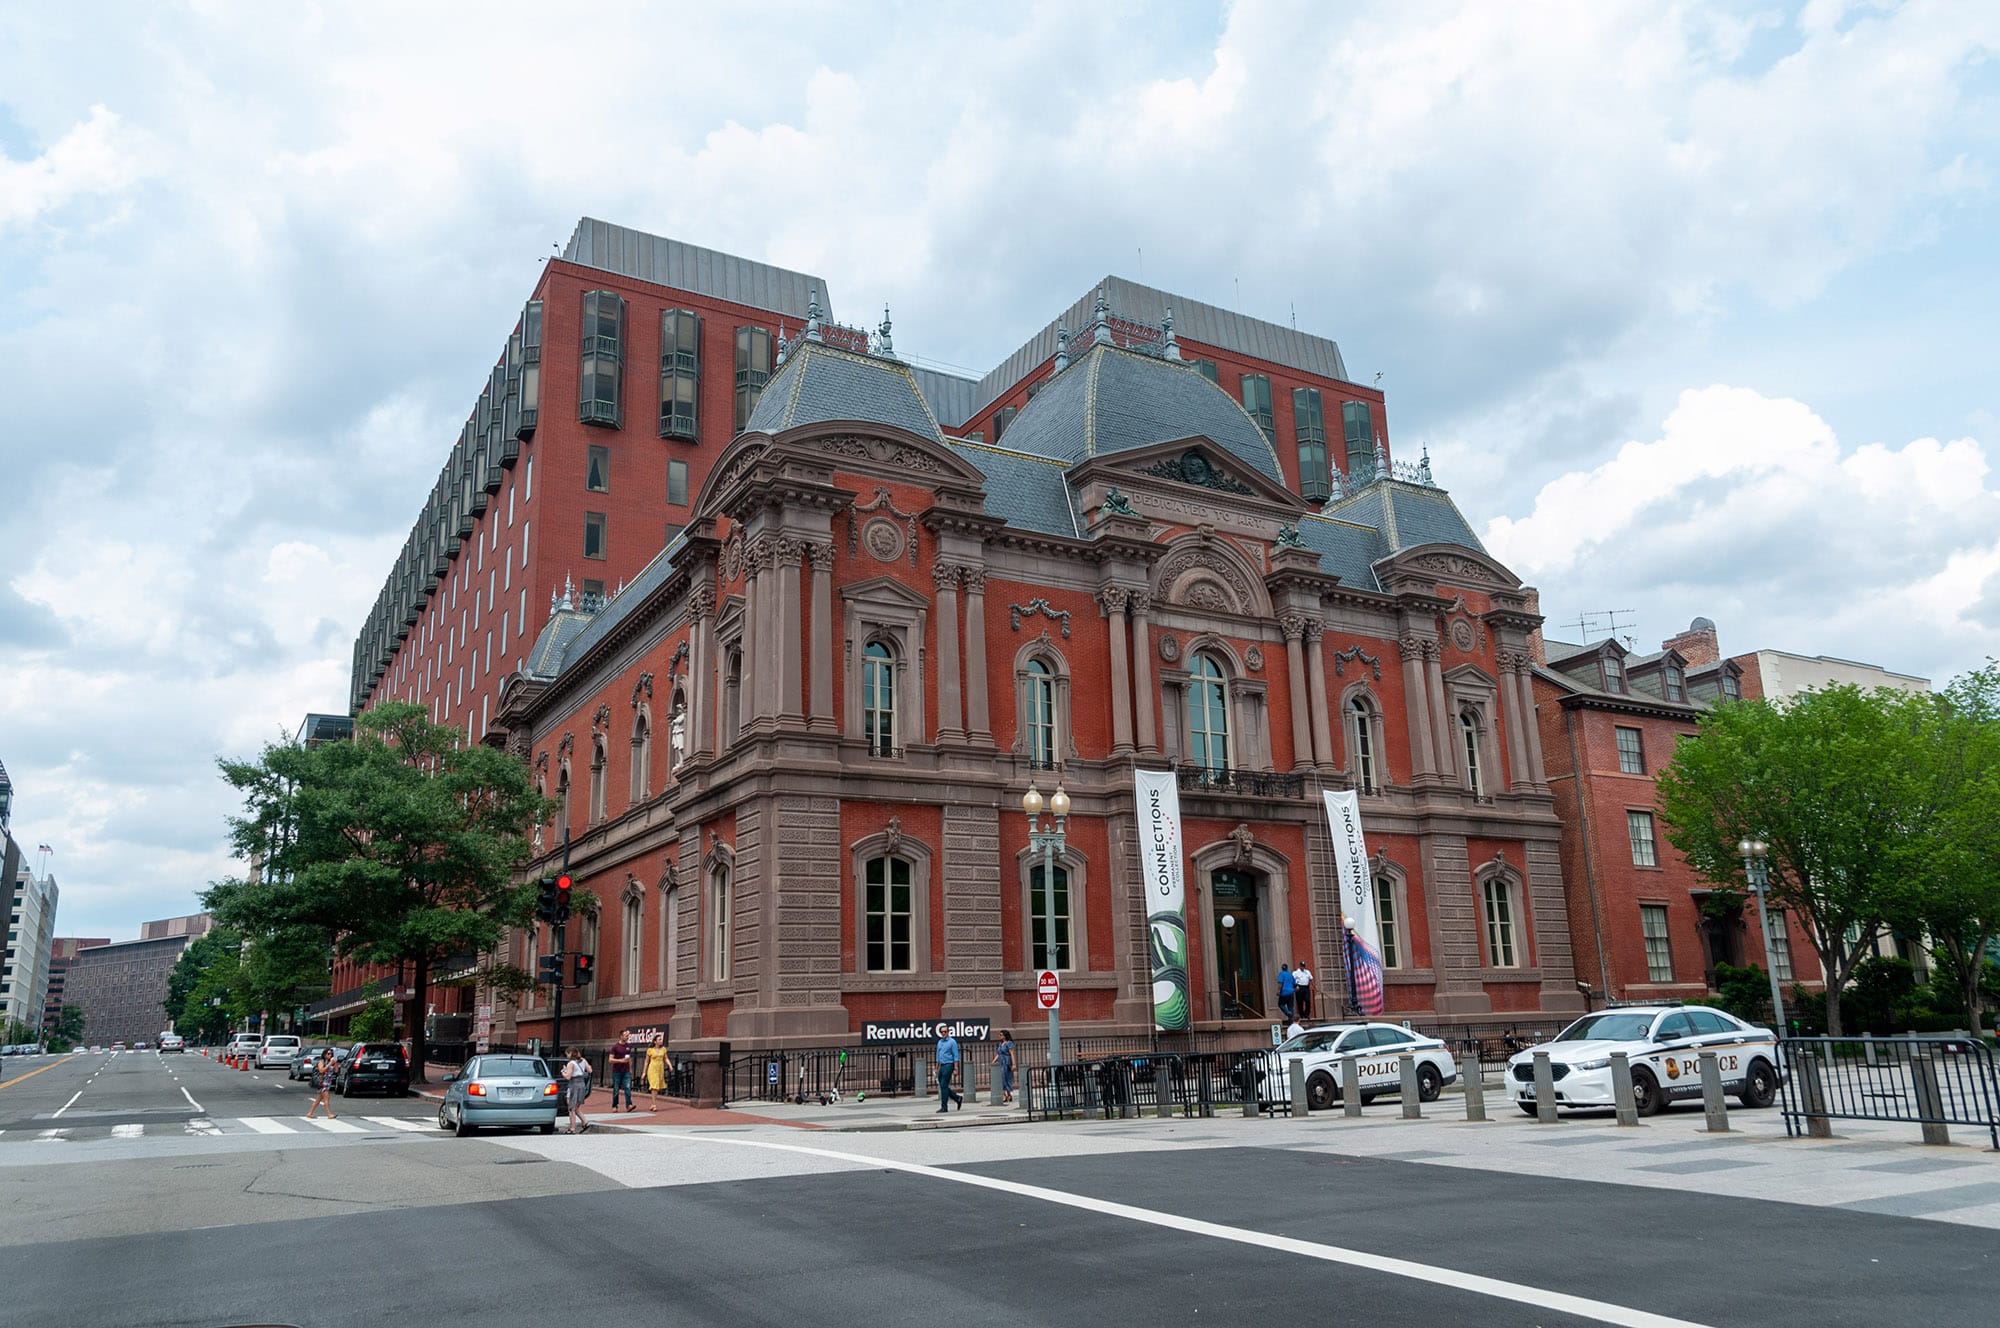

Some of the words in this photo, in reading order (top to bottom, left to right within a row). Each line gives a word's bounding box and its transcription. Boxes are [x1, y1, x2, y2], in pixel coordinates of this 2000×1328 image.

[1132, 492, 1209, 517] DEDICATED
[1214, 509, 1231, 522] TO
[1150, 789, 1170, 896] CONNECTIONS
[1341, 806, 1363, 905] CONNECTIONS
[1169, 851, 1177, 888] PERMANENT
[1172, 845, 1181, 882] COLLECTION
[626, 1028, 646, 1043] enwick
[866, 1022, 932, 1040] Renwick
[935, 1021, 989, 1040] Gallery
[1358, 1061, 1400, 1077] POLIC
[1683, 1055, 1738, 1076] POCE
